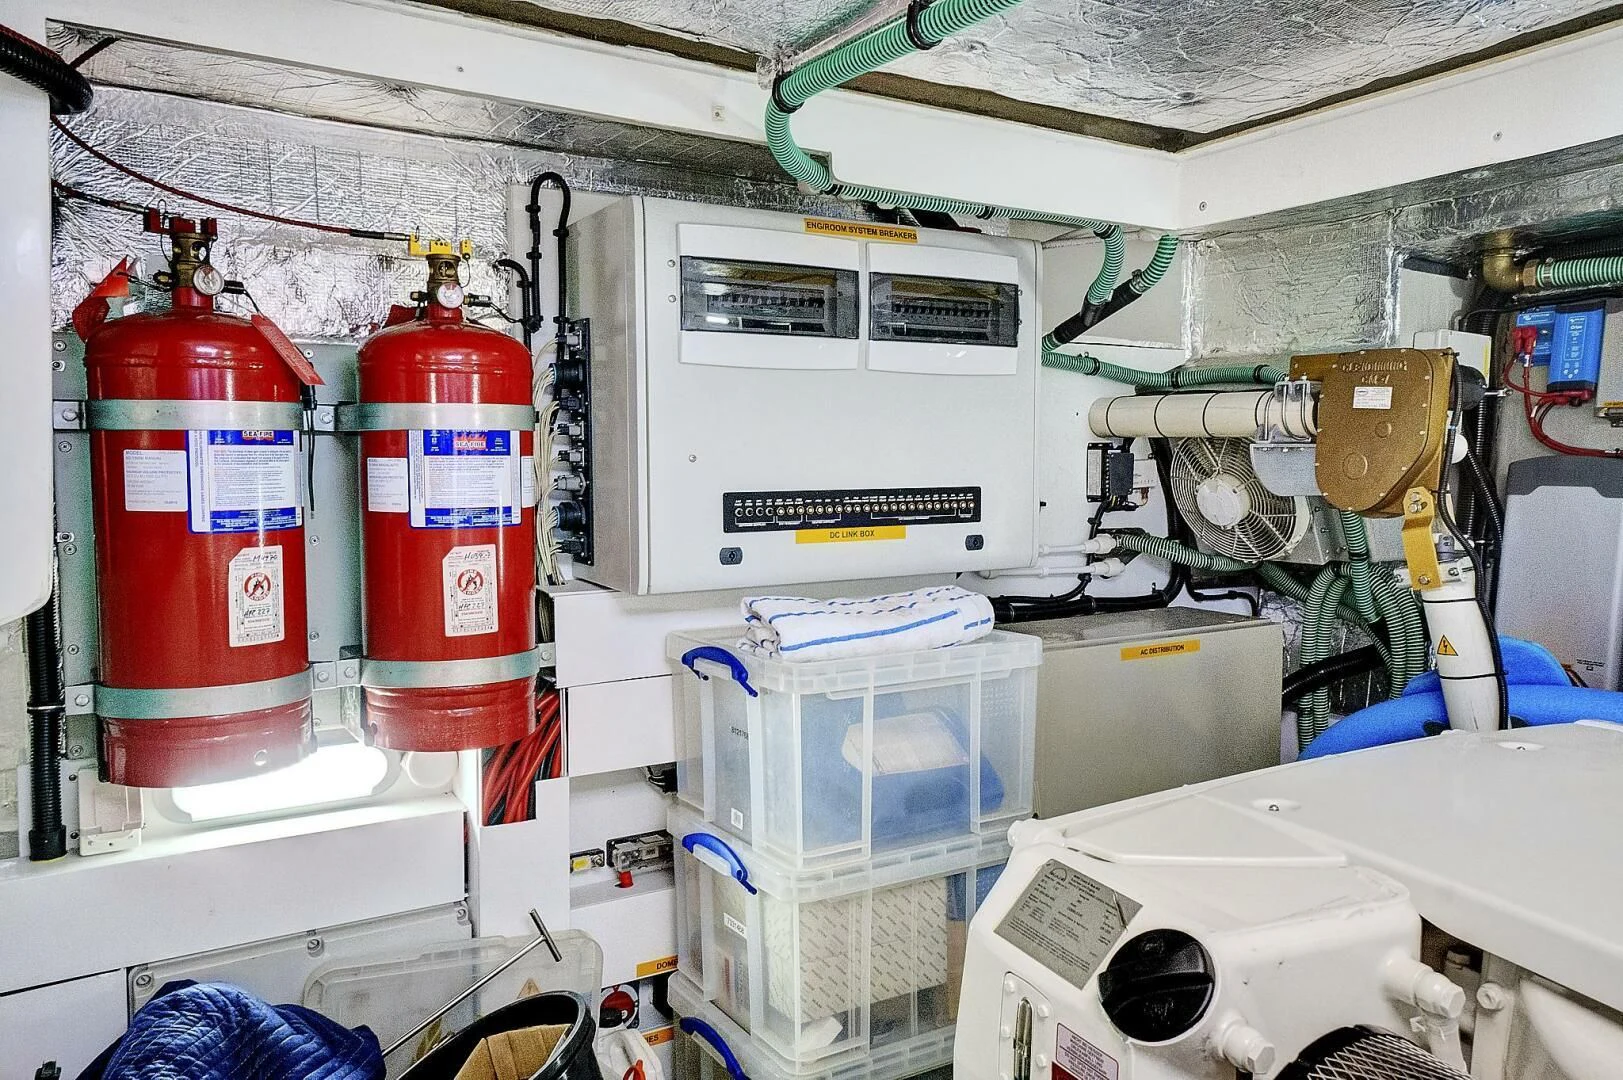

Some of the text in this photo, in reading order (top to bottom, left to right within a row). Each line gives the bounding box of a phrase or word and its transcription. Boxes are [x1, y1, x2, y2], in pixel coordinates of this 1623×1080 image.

[806, 221, 918, 240] ENG/ROOM SYSTEM BREAKERS
[829, 529, 875, 539] DC LINK BOX
[1149, 644, 1185, 655] DISTRIBUTION
